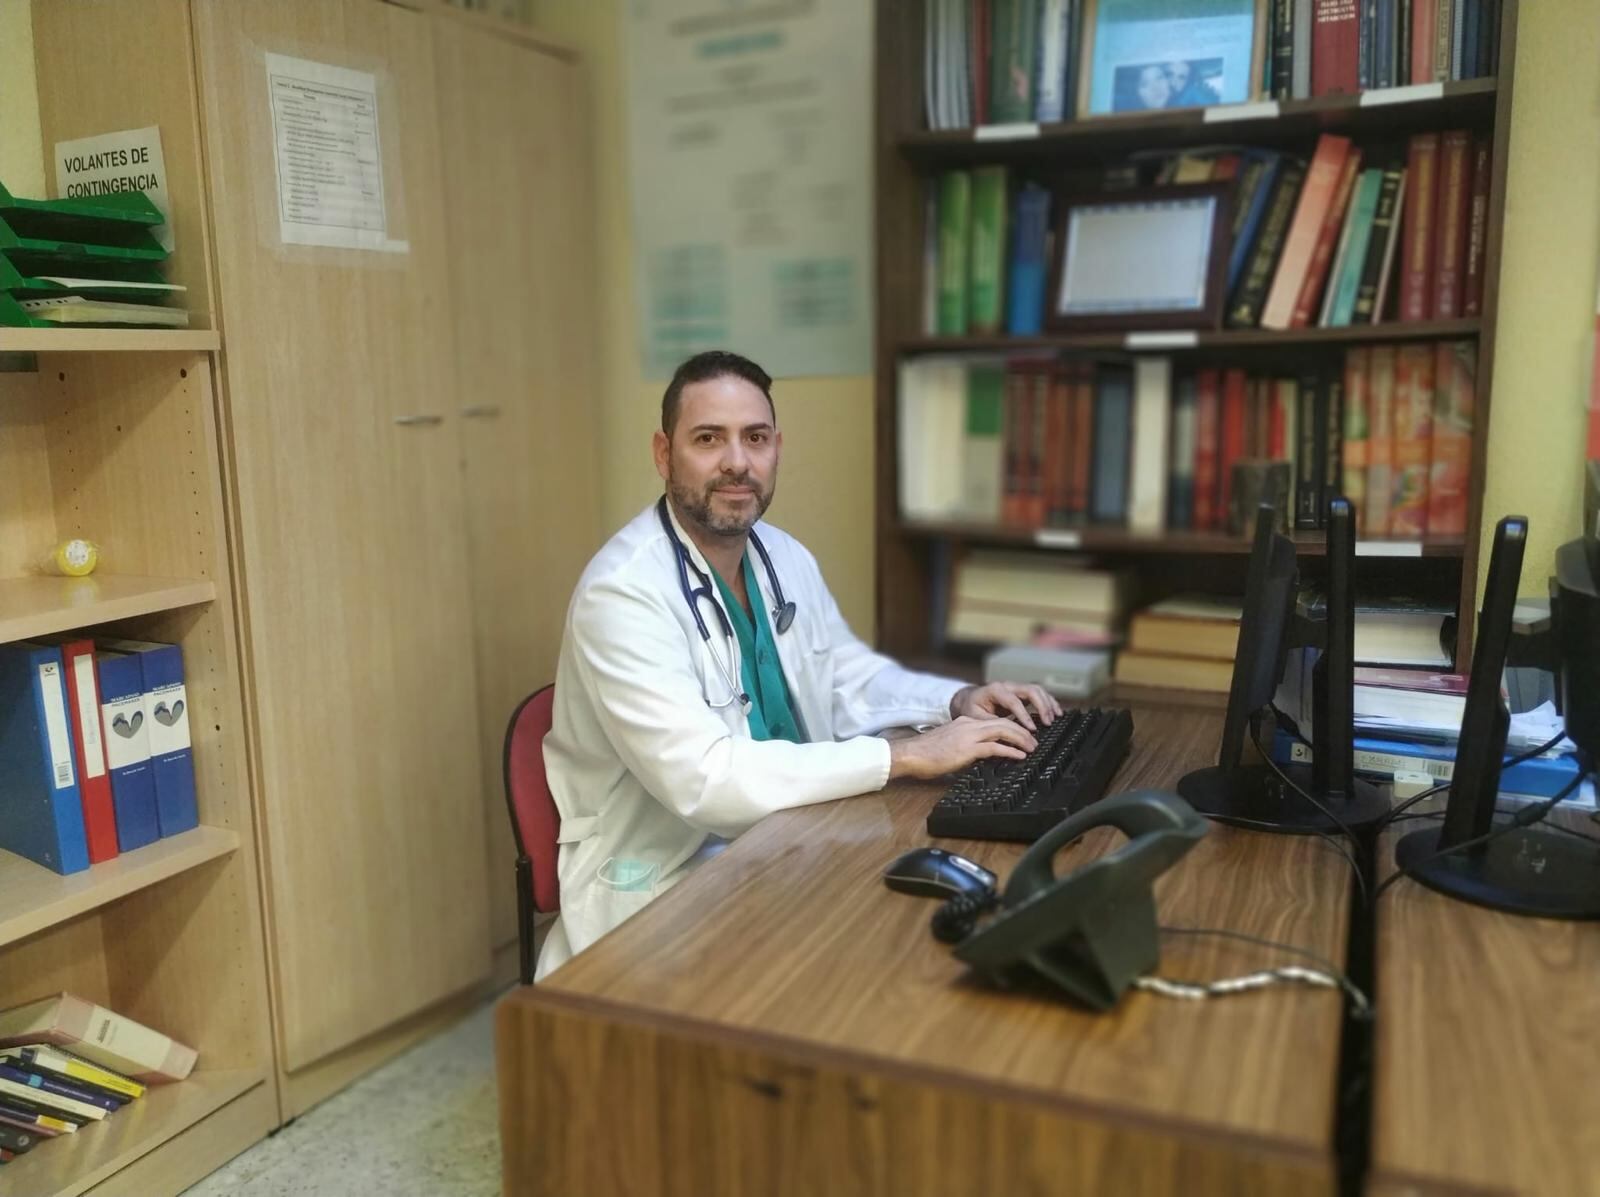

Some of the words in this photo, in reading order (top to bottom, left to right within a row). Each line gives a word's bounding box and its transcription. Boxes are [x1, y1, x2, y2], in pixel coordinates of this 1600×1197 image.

[64, 150, 128, 174] VOLANTES
[131, 147, 149, 164] DE
[67, 173, 158, 198] CONTINGENCIA
